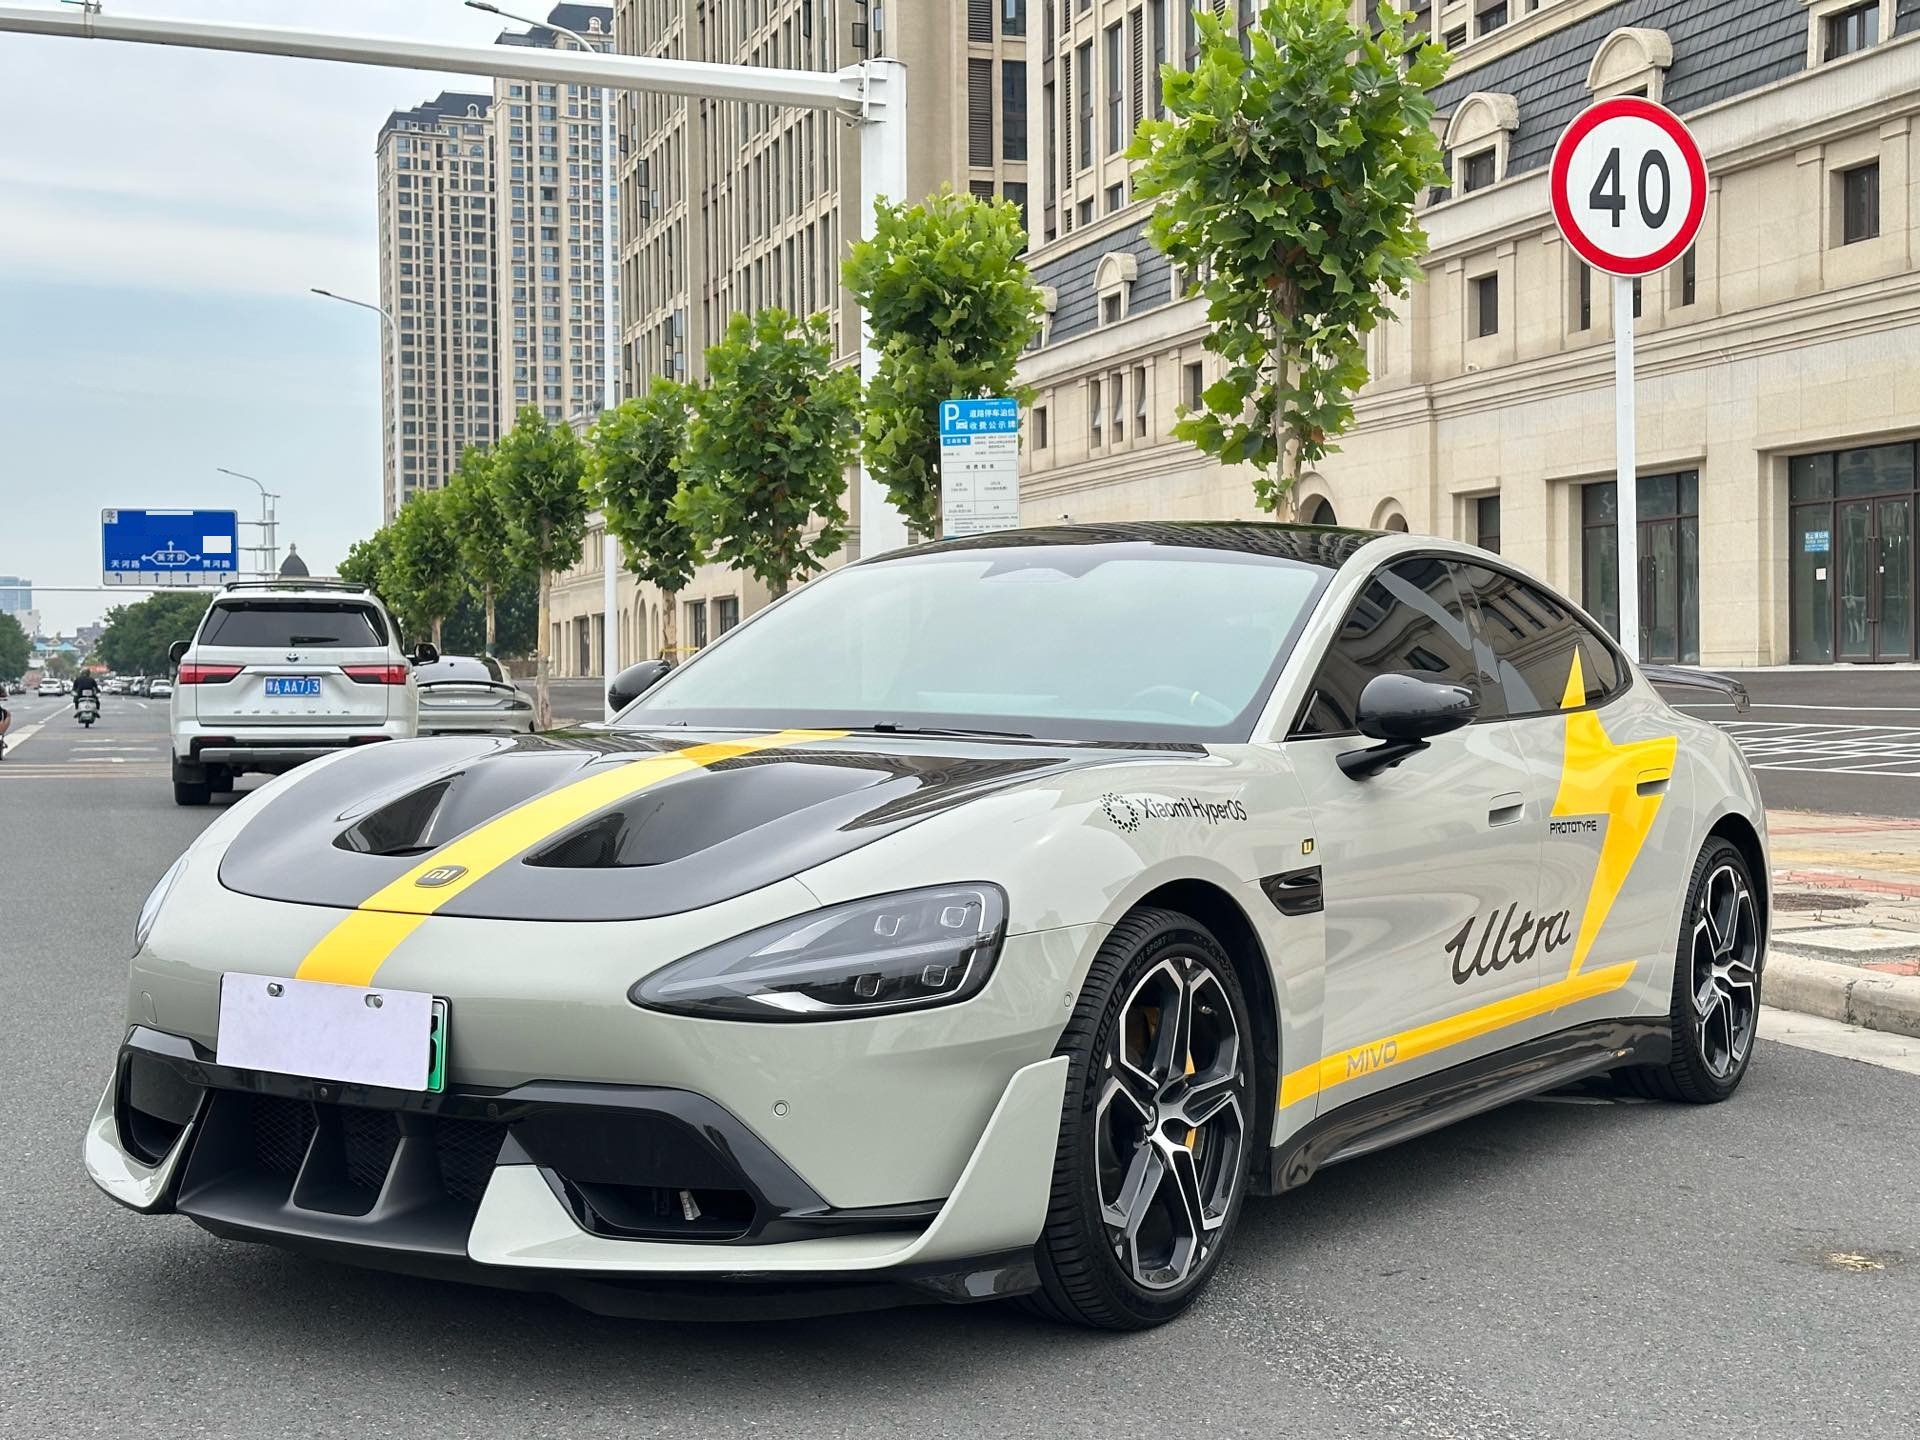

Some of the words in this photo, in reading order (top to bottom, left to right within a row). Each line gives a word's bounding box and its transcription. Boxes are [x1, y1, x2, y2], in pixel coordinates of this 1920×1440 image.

[1589, 147, 1671, 230] 40
[944, 403, 960, 431] P
[969, 408, 1016, 418] 道路停车泊位
[969, 420, 1016, 430] 收费公示牌
[111, 560, 140, 569] 天河路
[1136, 797, 1190, 820] Xiaomi
[1190, 798, 1248, 825] HyperOS
[1550, 820, 1597, 835] PROTOTYPE
[1445, 901, 1572, 985] Ultra
[1346, 1040, 1398, 1077] MIVO
